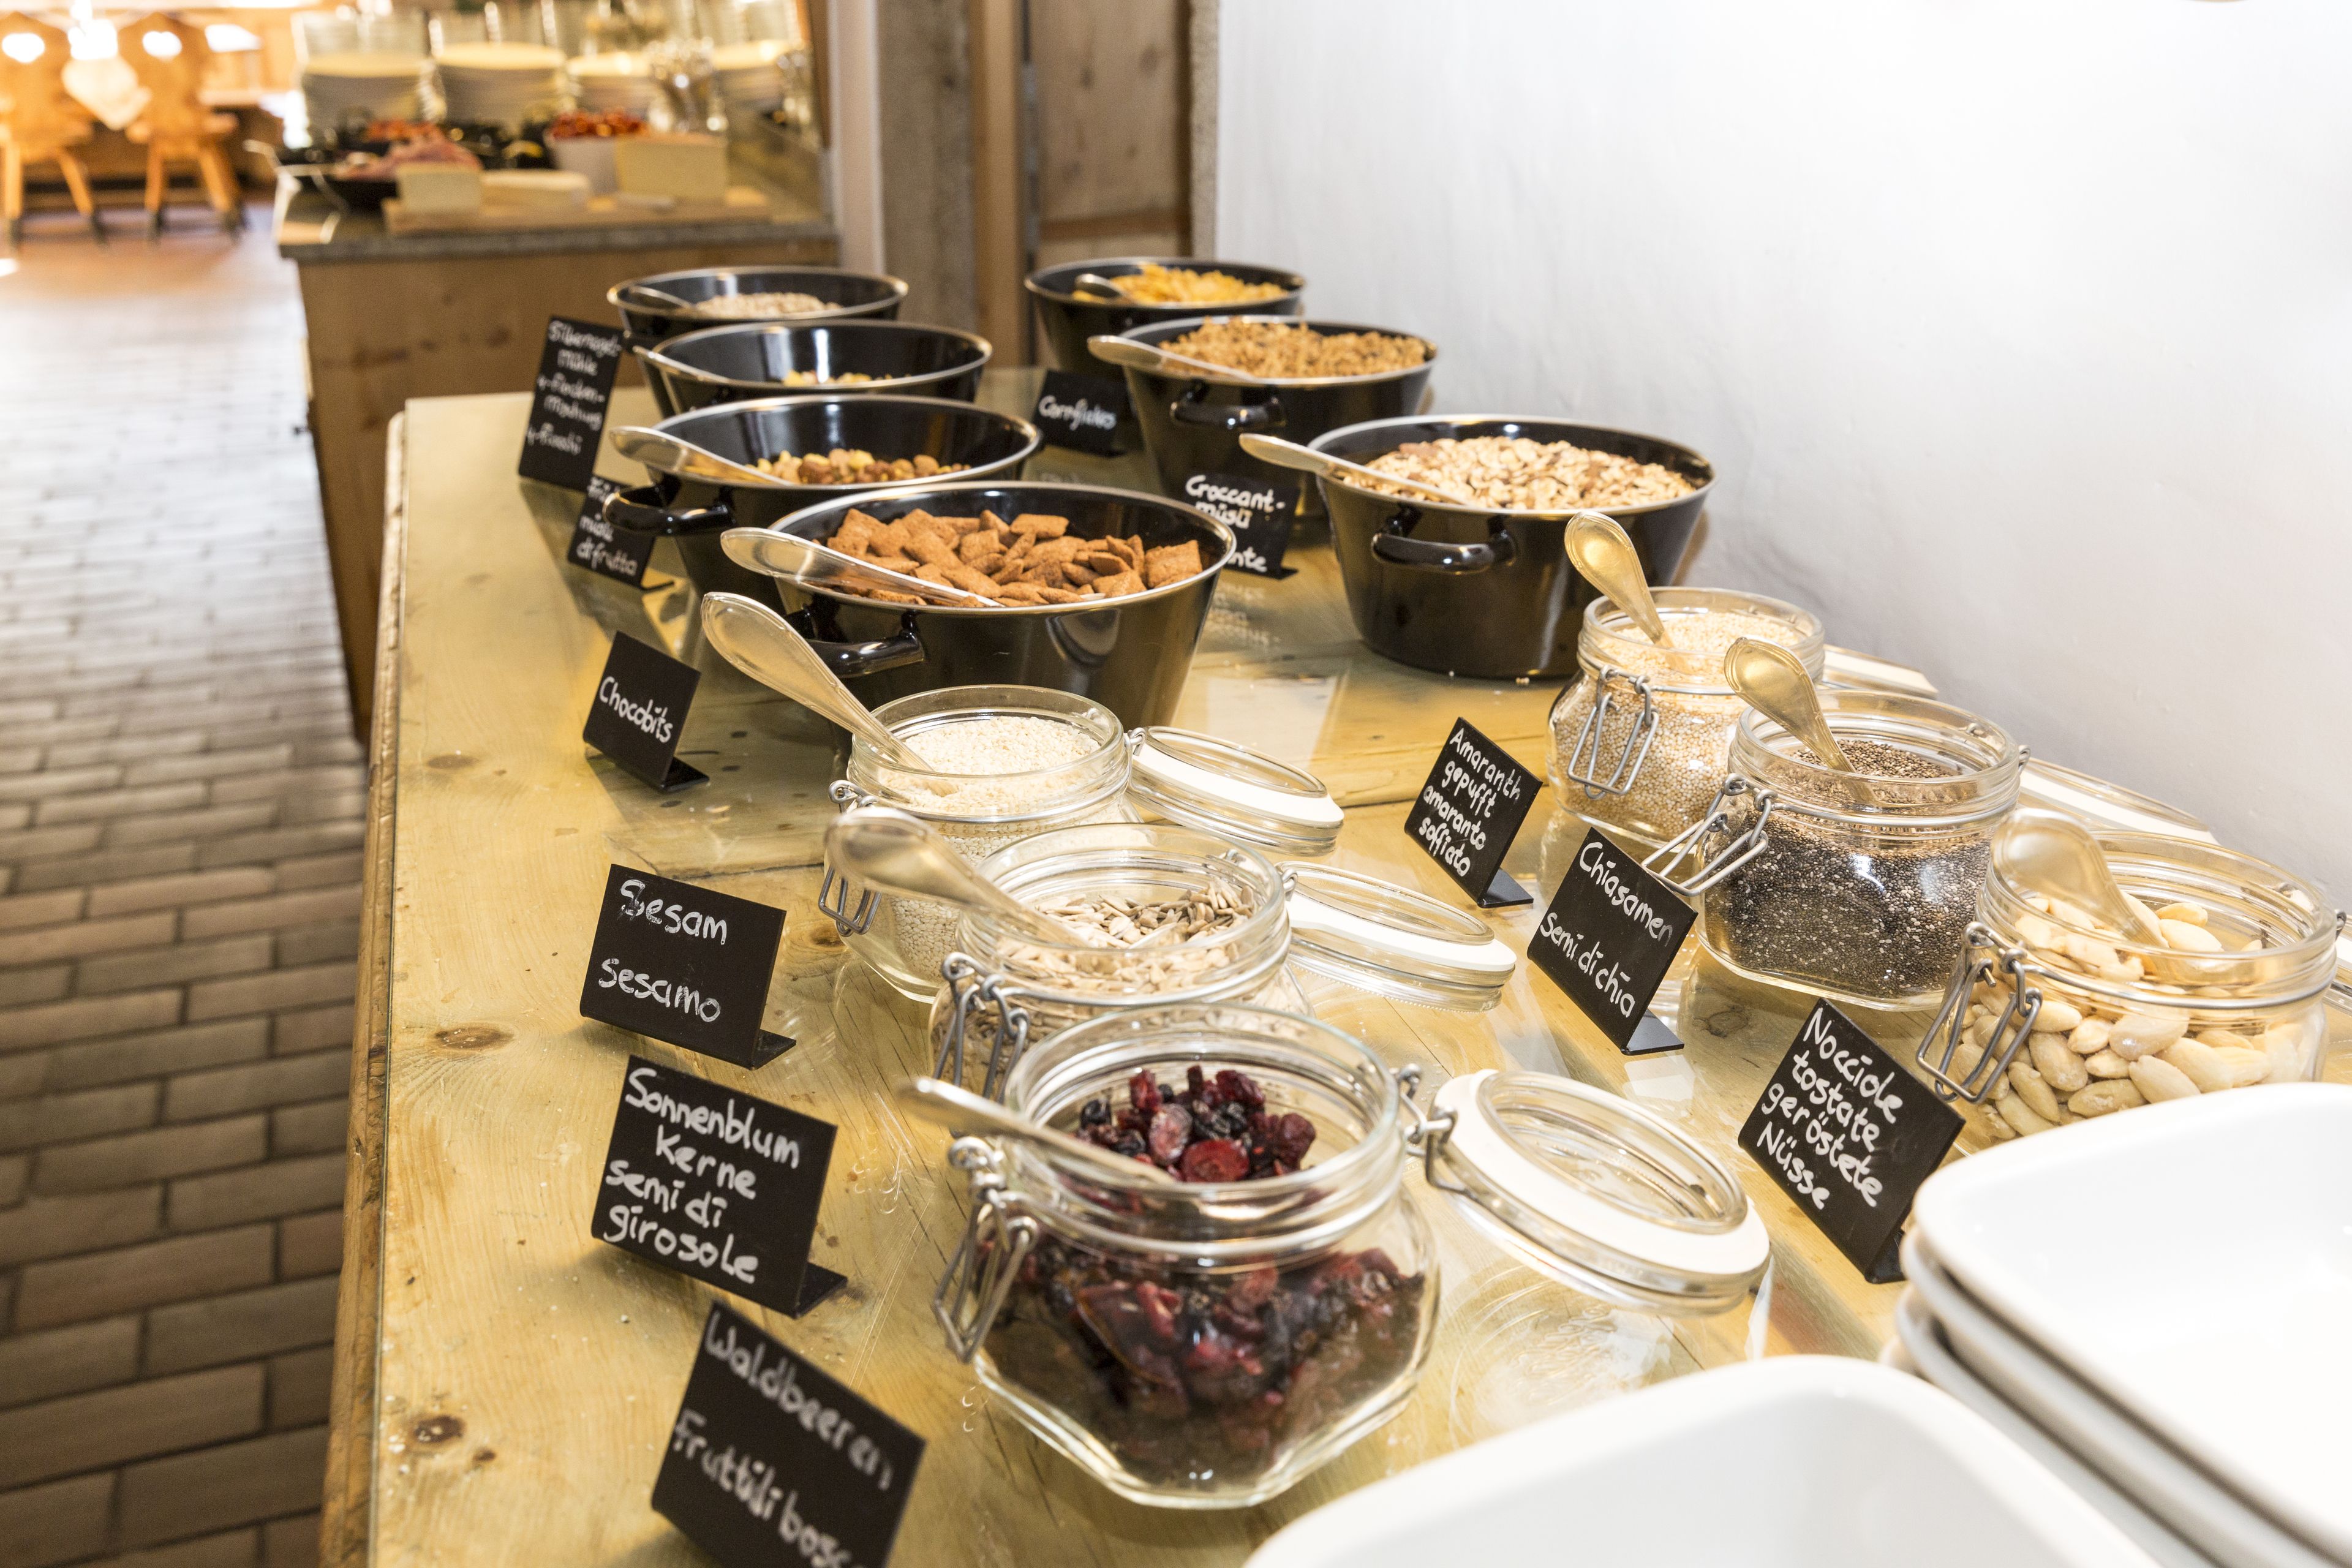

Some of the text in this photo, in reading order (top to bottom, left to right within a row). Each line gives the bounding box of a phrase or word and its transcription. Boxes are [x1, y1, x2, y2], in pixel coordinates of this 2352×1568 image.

[599, 676, 673, 744] Chocobits
[1442, 761, 1496, 818] gepufft
[1449, 728, 1520, 800] Amaranth
[1419, 818, 1471, 876] soffiato
[1423, 785, 1487, 850] amaranto
[620, 879, 727, 945] Sesam
[1580, 842, 1673, 947] Chiasamen
[1578, 941, 1604, 976] di
[1595, 962, 1636, 1018] chia
[1792, 1049, 1880, 1153] tostate
[1803, 1007, 1903, 1125] Nocciole
[625, 1068, 800, 1169] Sonnenblum
[1762, 1083, 1883, 1207] geröstete
[1757, 1121, 1830, 1210] Nüsse
[685, 1191, 728, 1228] di
